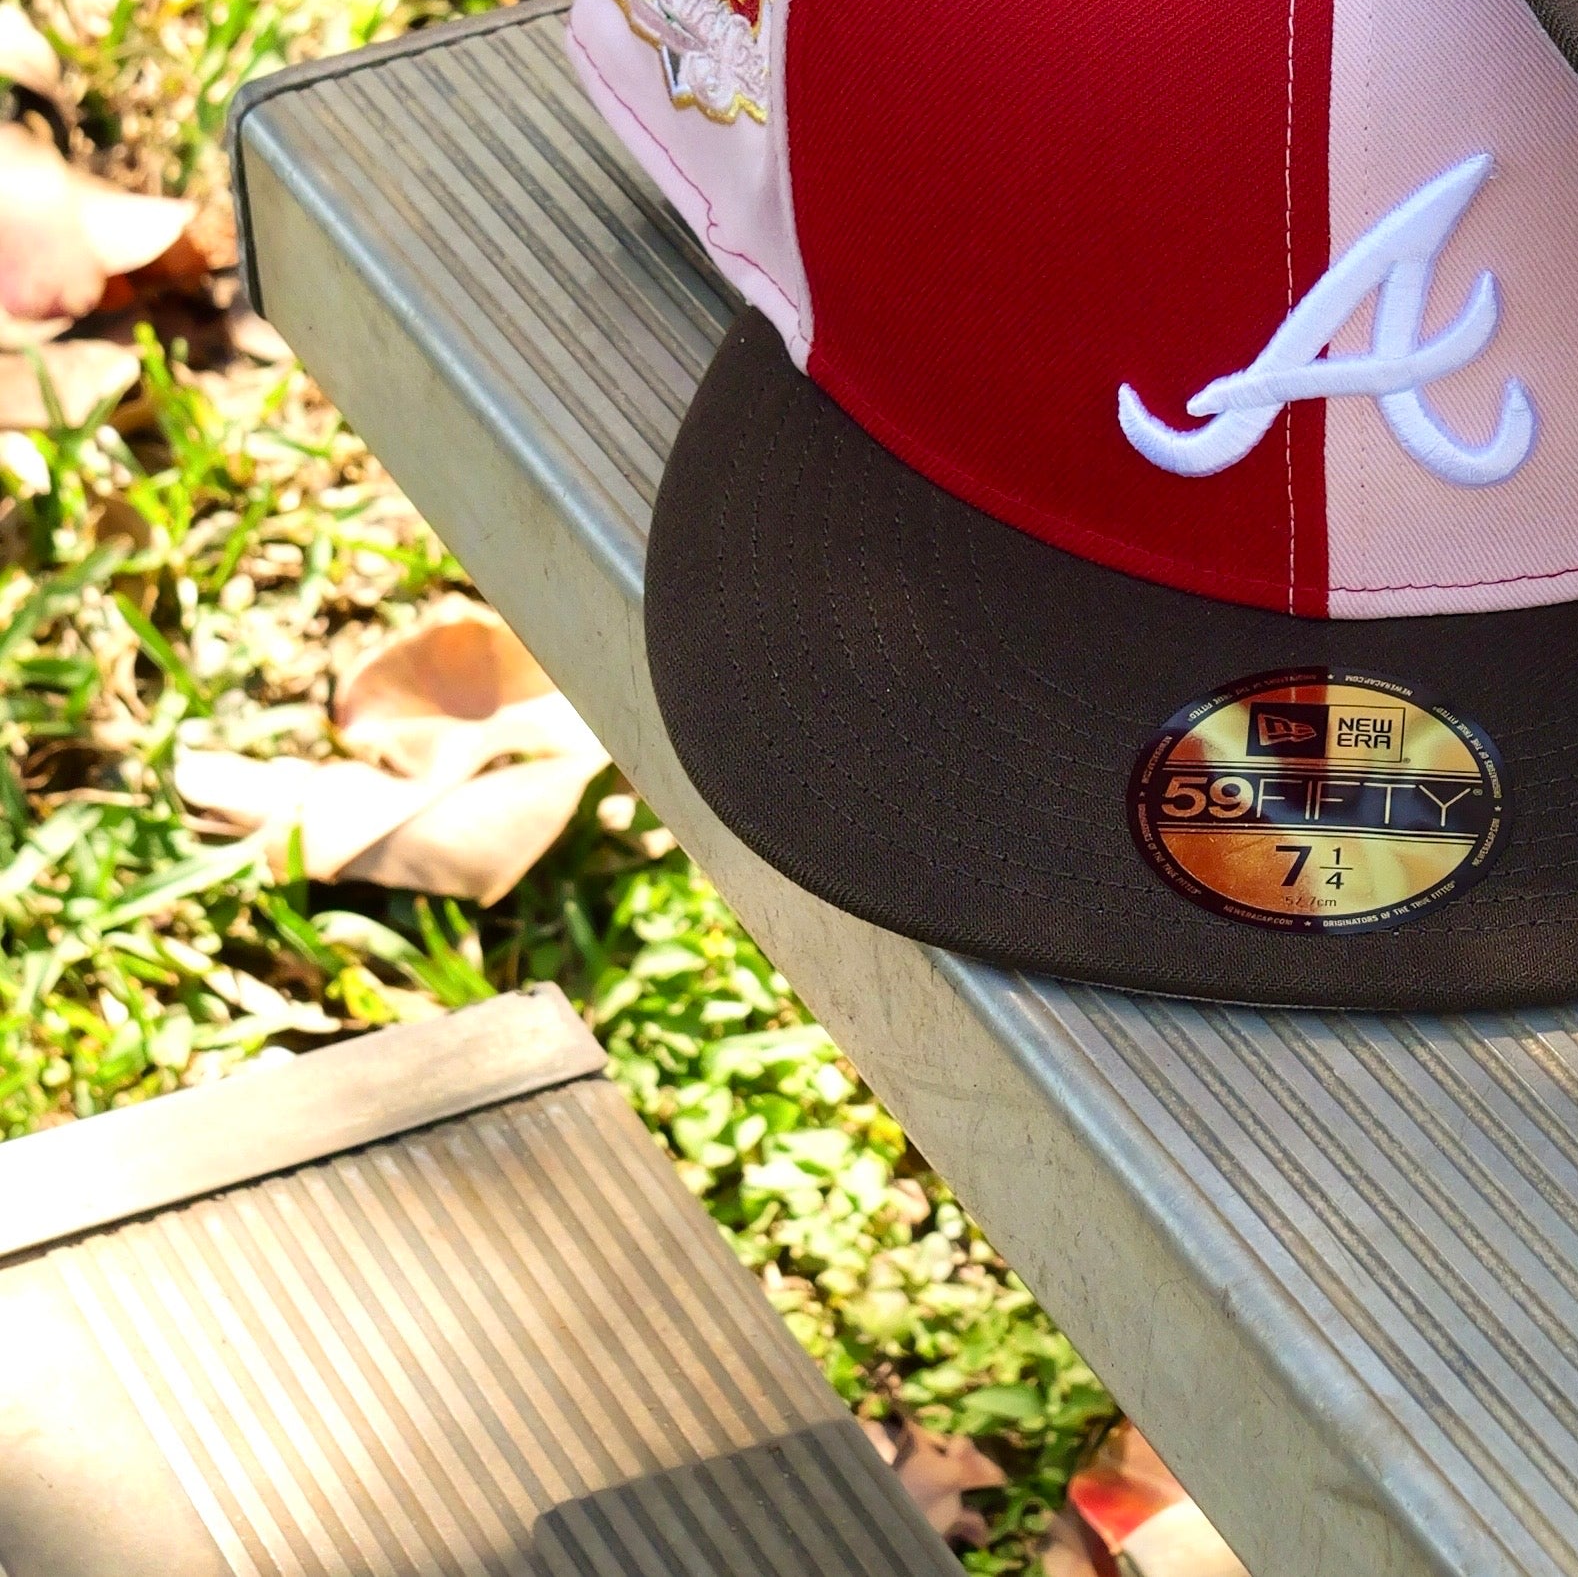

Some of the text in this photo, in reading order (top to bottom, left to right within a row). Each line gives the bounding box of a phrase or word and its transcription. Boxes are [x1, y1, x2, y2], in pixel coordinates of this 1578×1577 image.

[1118, 152, 1539, 489] A
[1338, 717, 1393, 734] NEW
[1336, 732, 1391, 750] ERA
[1275, 845, 1313, 887] 7
[1391, 904, 1410, 916] THE
